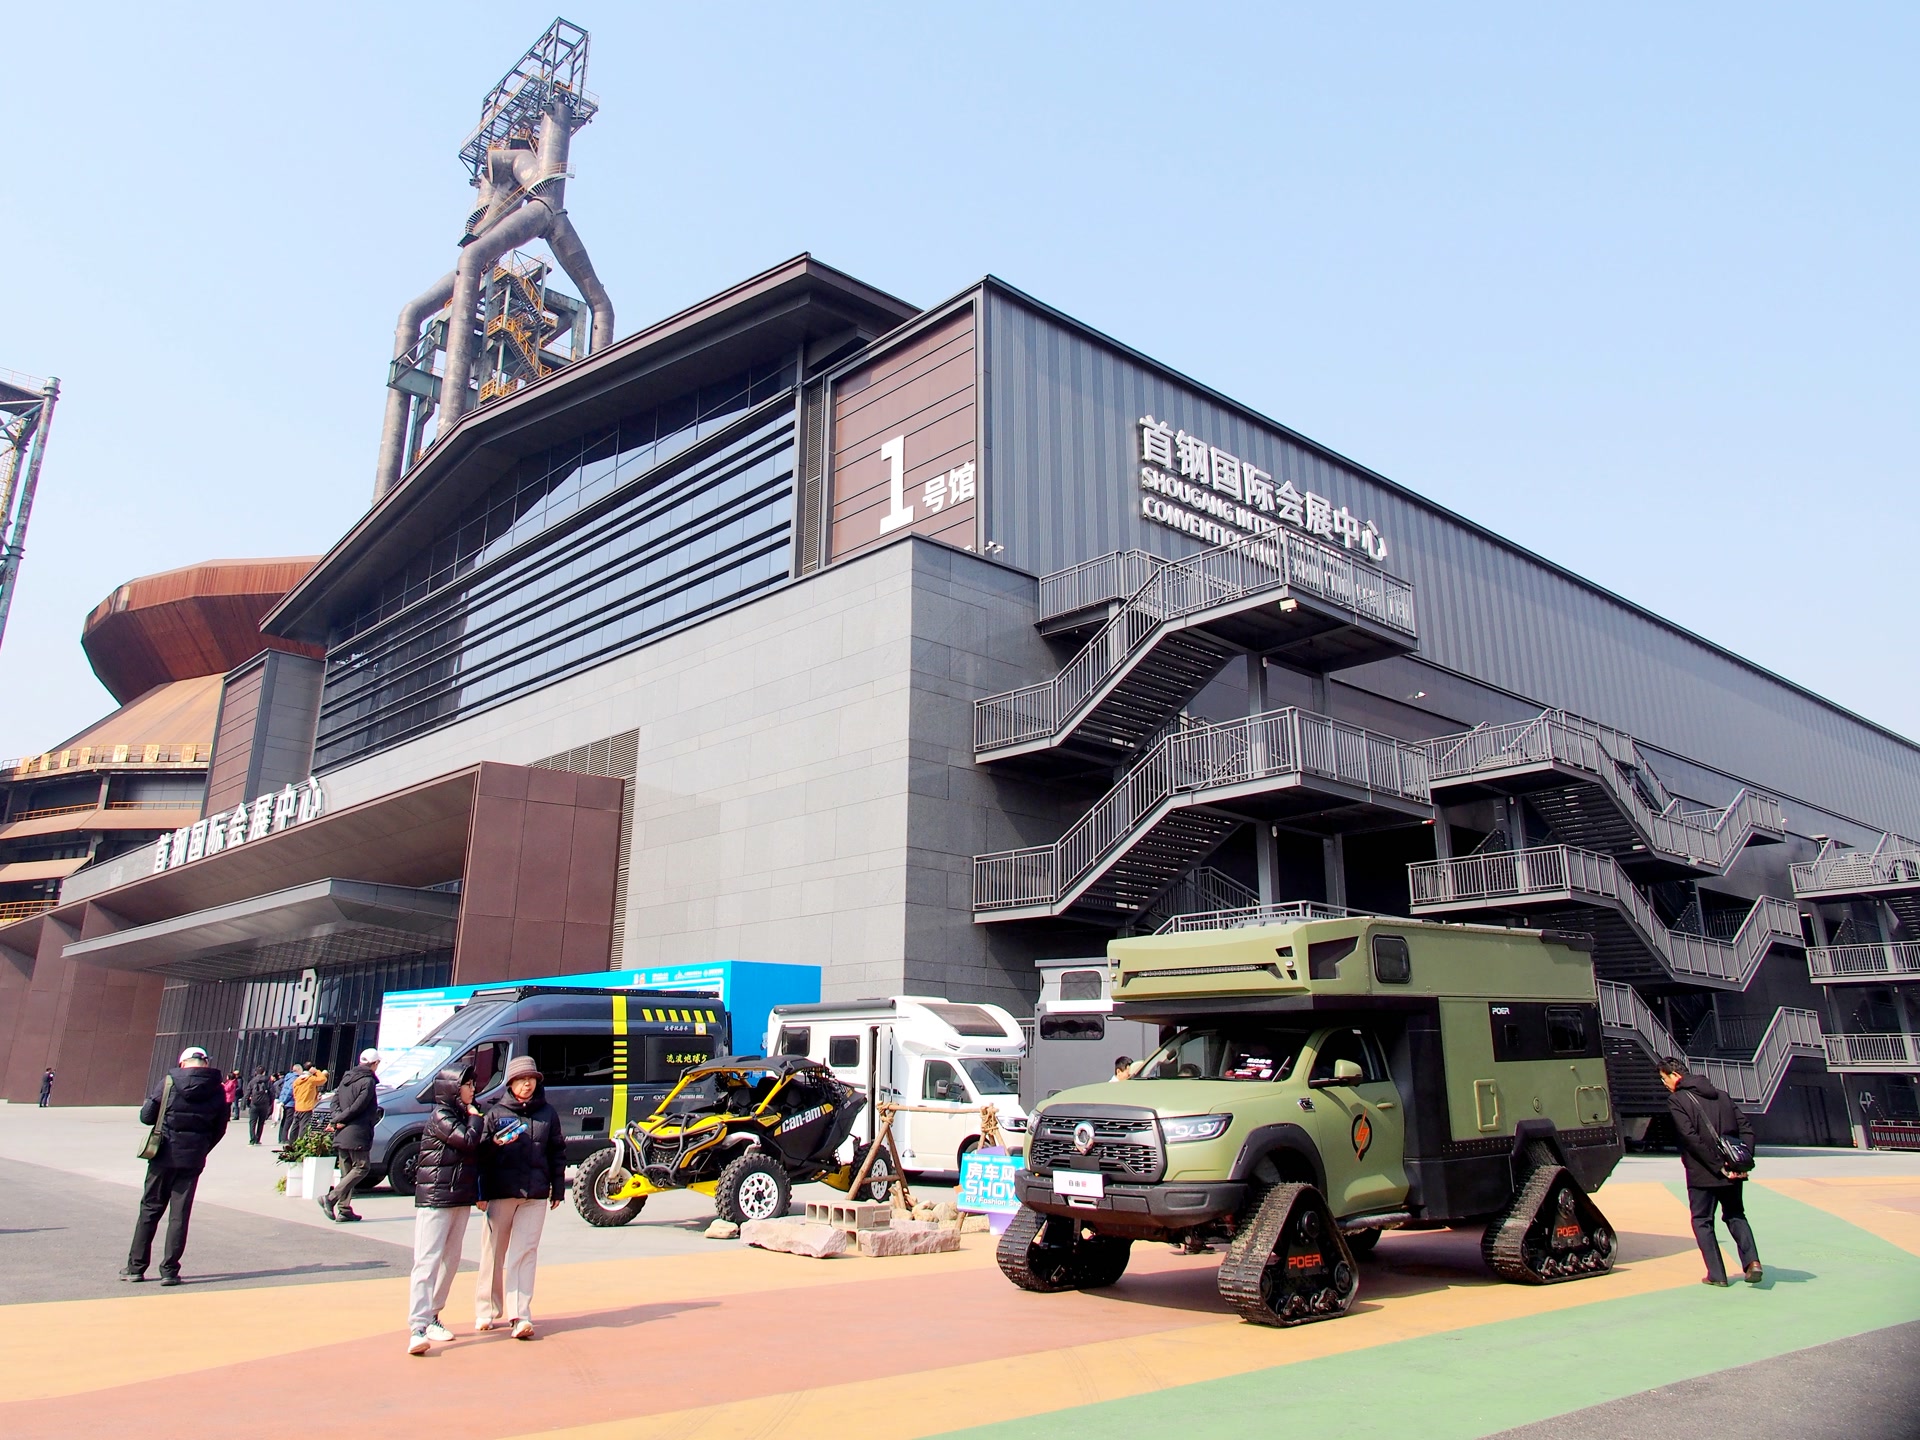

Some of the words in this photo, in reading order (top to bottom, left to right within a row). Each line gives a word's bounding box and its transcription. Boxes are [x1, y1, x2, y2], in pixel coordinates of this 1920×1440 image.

[1139, 415, 1388, 562] 首钢国际会展中心
[1142, 466, 1235, 522] SHOUGANG
[153, 776, 322, 874] 首钢国际会展中心
[296, 968, 317, 1024] B
[1491, 1007, 1510, 1015] POER
[573, 1106, 594, 1115] FORD
[781, 1105, 822, 1133] can-am
[1557, 1225, 1579, 1238] POER
[1288, 1254, 1321, 1270] POER
